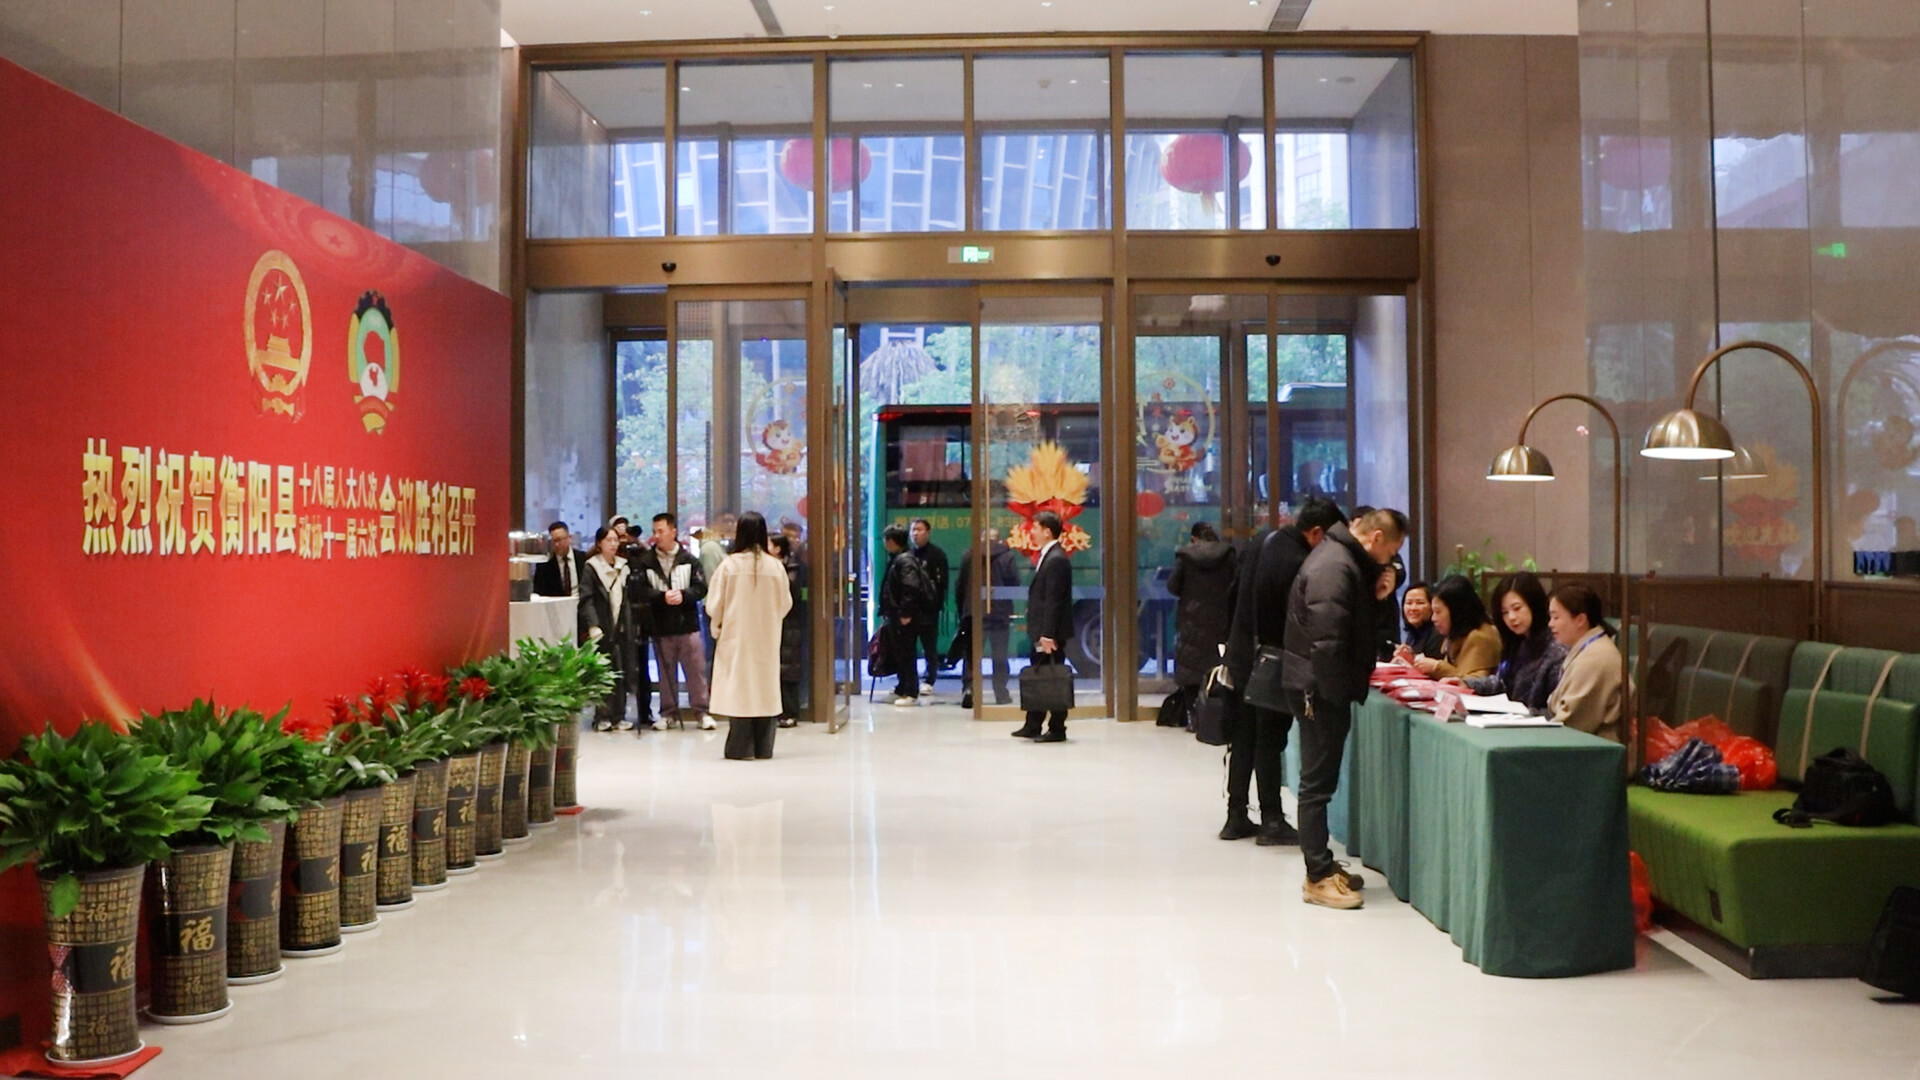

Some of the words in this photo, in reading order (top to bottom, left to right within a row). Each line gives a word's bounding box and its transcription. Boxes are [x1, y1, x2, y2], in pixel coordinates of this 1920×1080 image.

[82, 437, 297, 557] 热烈祝贺衡阳县
[299, 462, 378, 510] 十八届人大八次
[299, 515, 378, 560] 政协十一届六次
[378, 474, 477, 556] 会议胜利召开
[180, 916, 216, 954] 福
